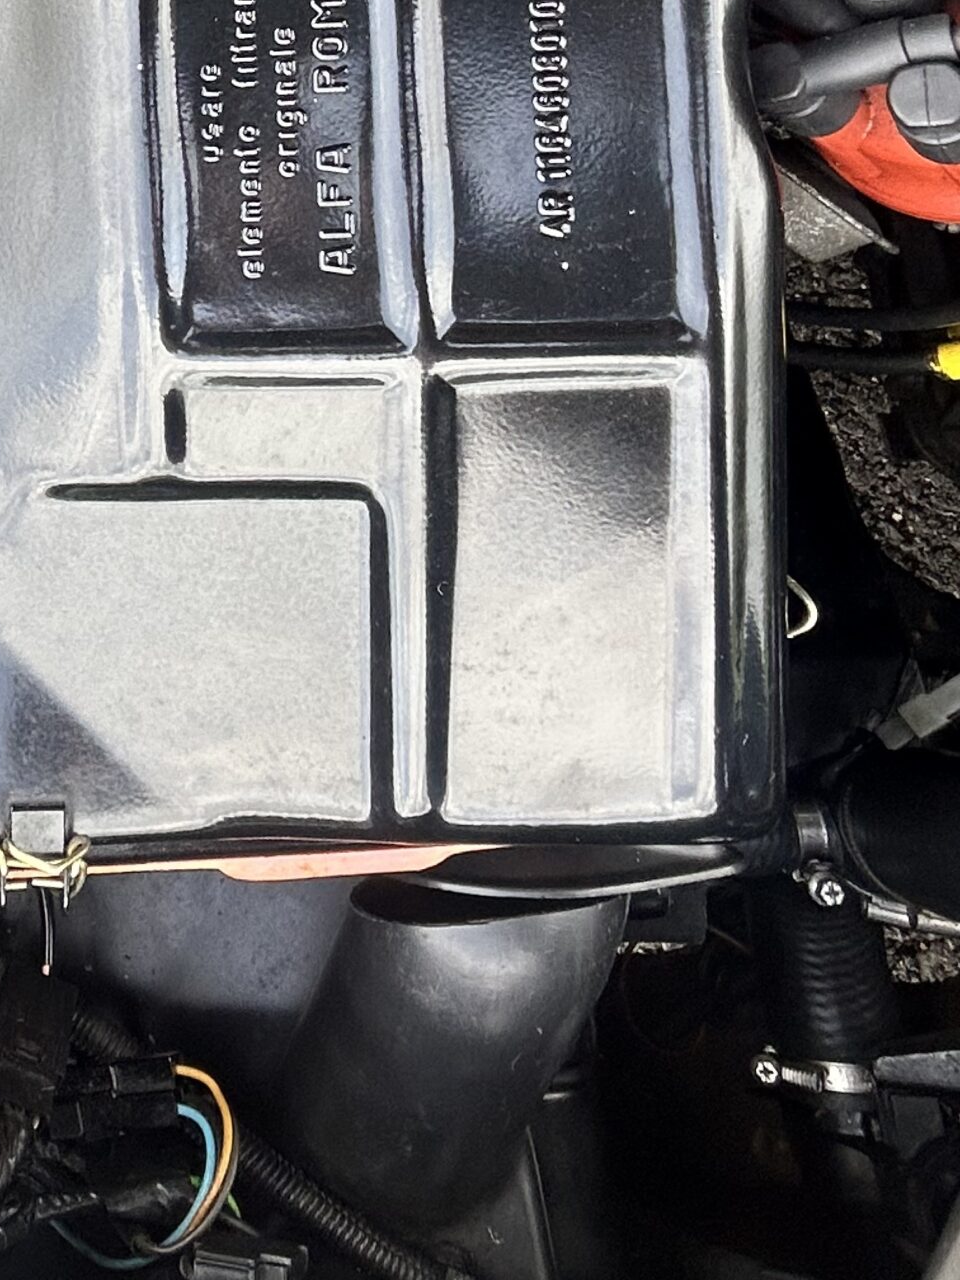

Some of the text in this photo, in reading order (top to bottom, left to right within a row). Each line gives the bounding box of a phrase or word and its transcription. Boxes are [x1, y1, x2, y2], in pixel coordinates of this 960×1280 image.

[200, 64, 224, 162] usare
[269, 28, 308, 177] originale
[233, 125, 265, 279] elemento
[315, 142, 356, 275] ALFA
